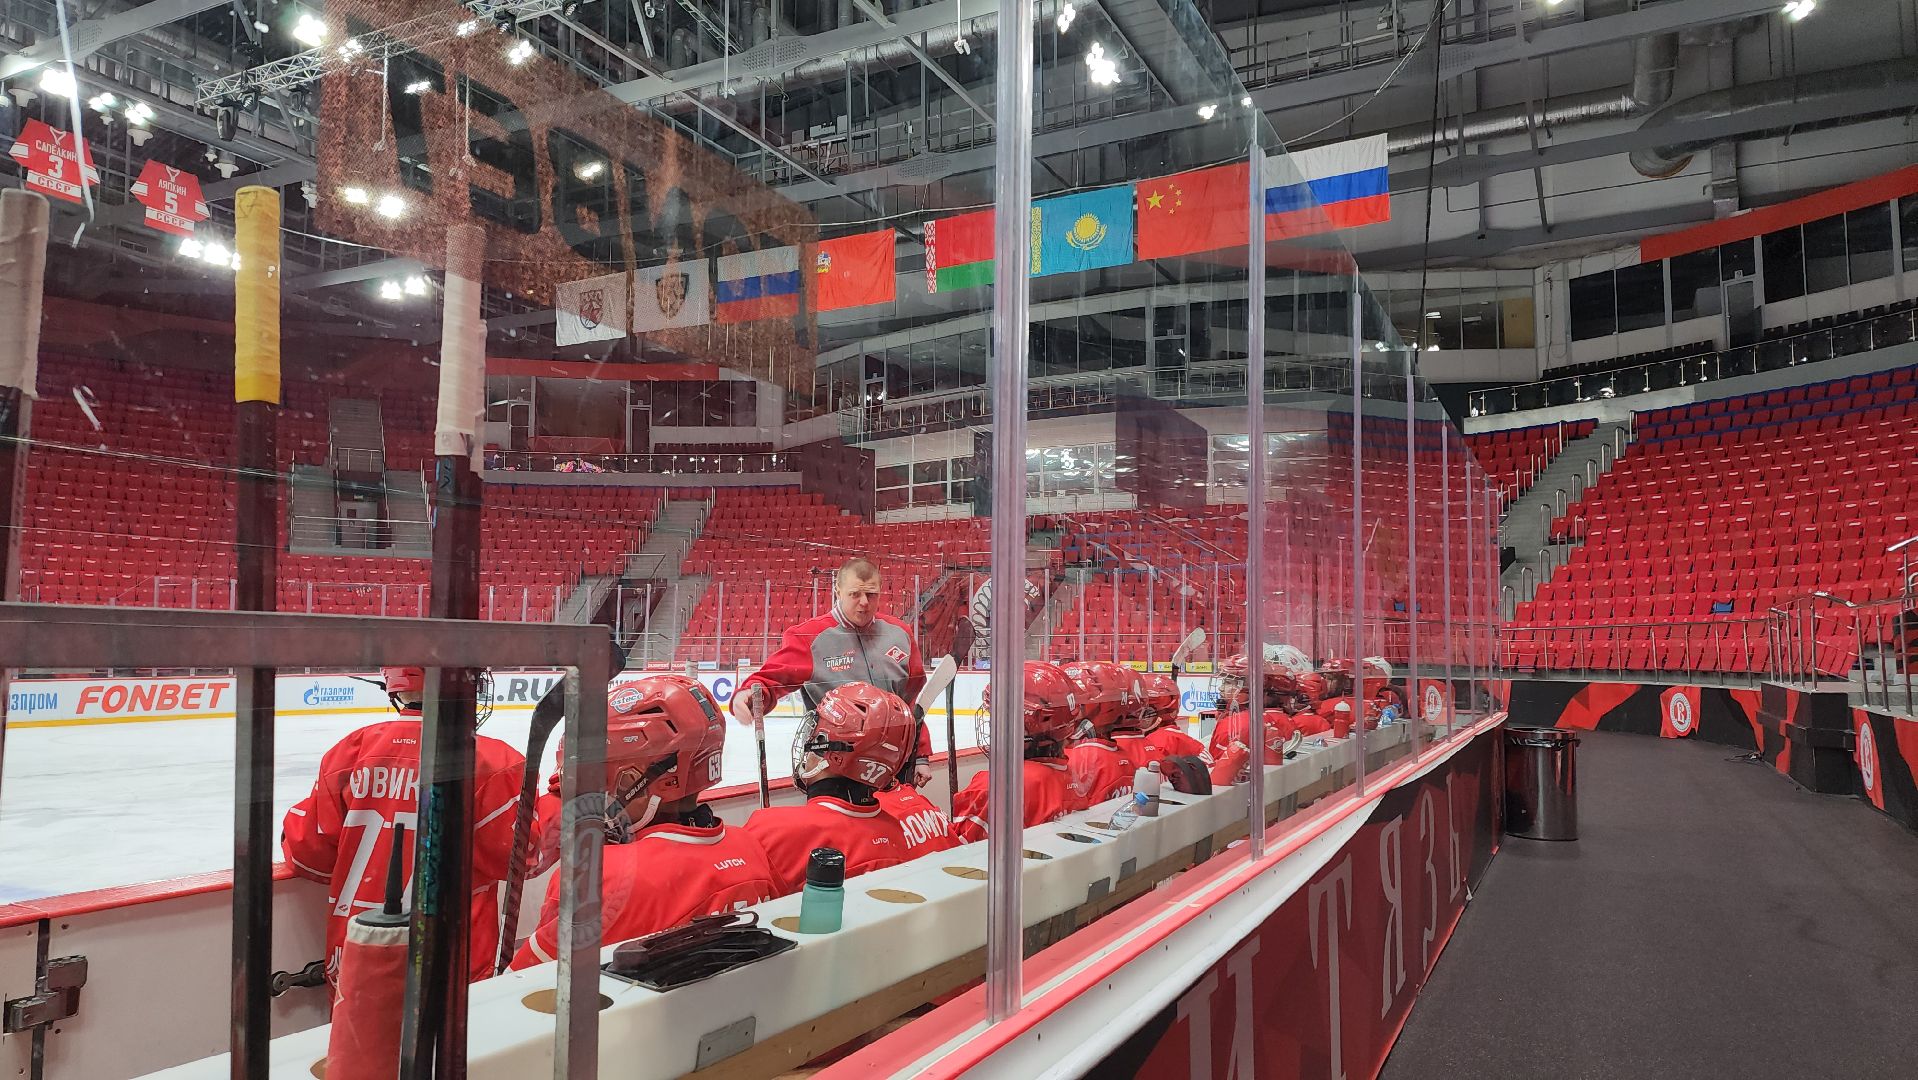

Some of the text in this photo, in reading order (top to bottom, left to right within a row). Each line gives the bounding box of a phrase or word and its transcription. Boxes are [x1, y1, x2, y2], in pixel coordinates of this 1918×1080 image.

[35, 139, 78, 163] САПЁЛКИН
[47, 155, 64, 180] 3
[37, 176, 72, 193] СССР
[157, 178, 187, 197] ЛЯПКИН
[164, 191, 179, 214] 5
[156, 211, 186, 227] СССР
[75, 682, 231, 715] FONBET
[708, 753, 722, 781] 63
[860, 761, 887, 784] 37
[713, 857, 747, 871] LUTCH
